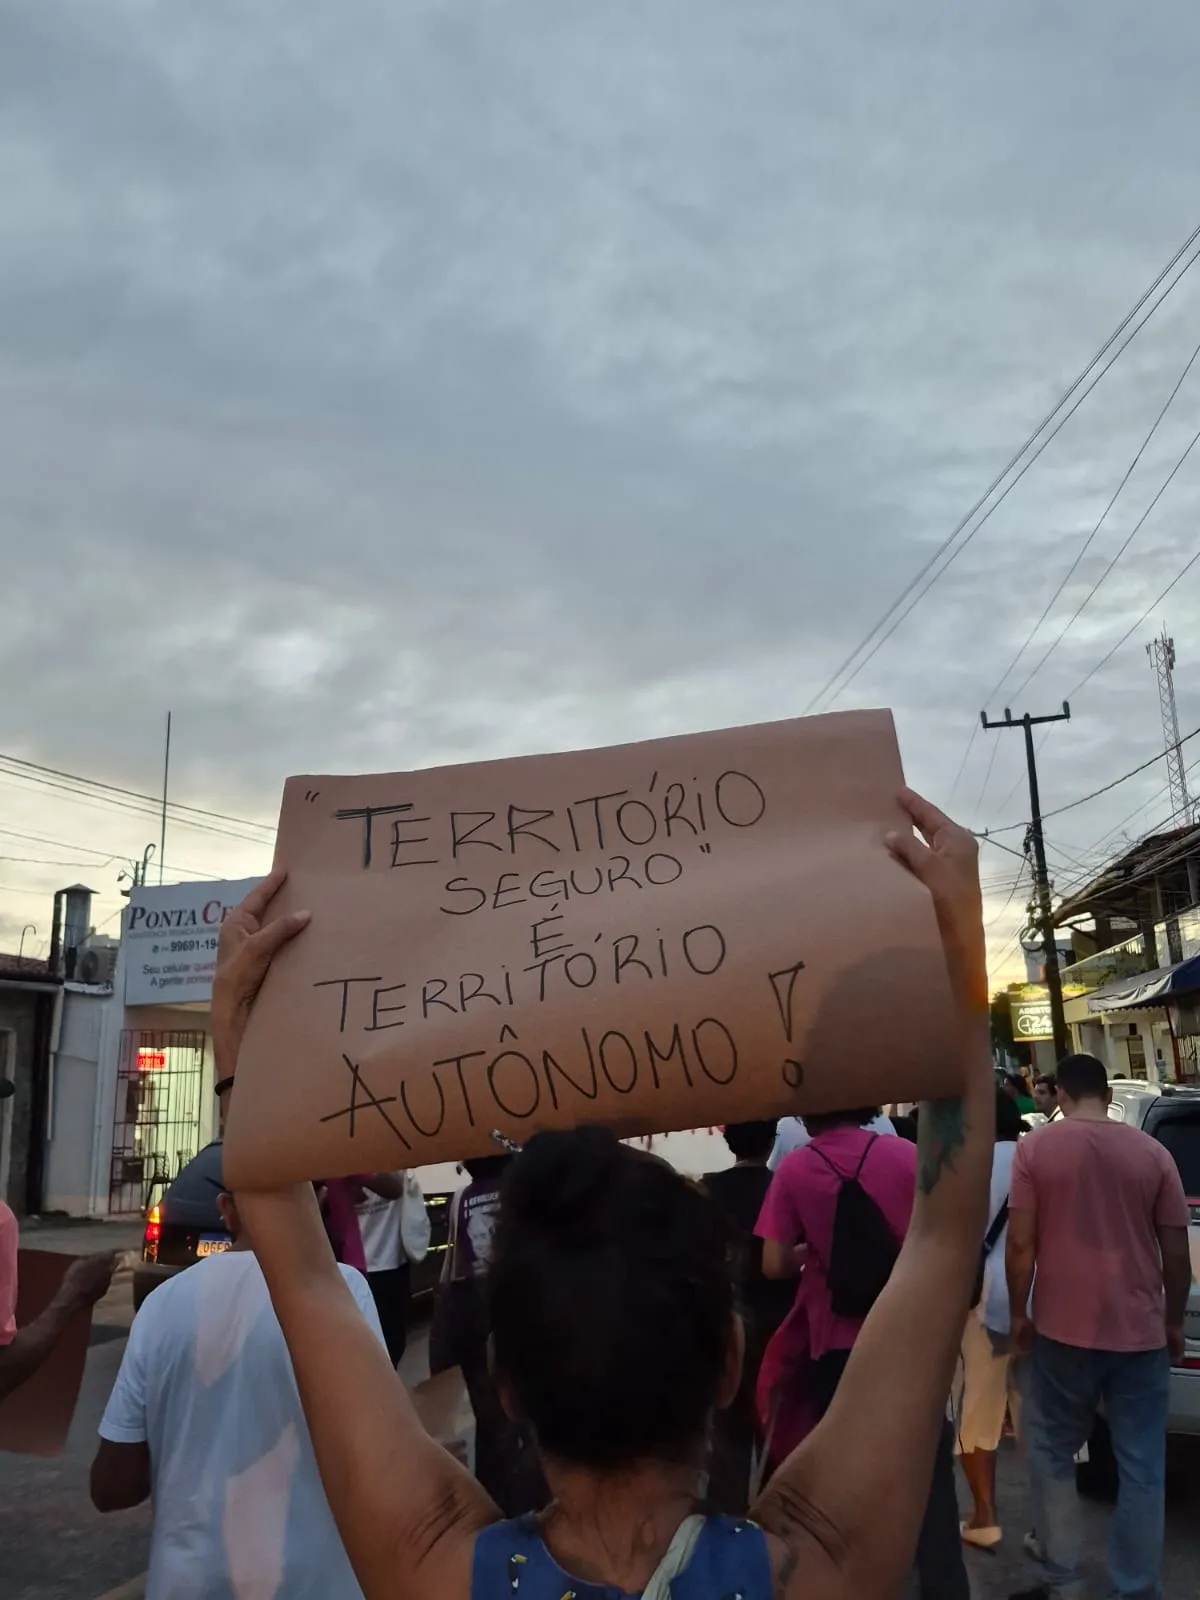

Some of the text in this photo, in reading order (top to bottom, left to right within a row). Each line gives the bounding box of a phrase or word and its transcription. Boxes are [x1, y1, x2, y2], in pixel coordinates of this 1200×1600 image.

[440, 843, 712, 915] SEGURO"
[128, 906, 198, 930] PONTA
[531, 903, 574, 959] É
[313, 924, 726, 1032] TERRITÓRIO
[1031, 1015, 1052, 1028] 24
